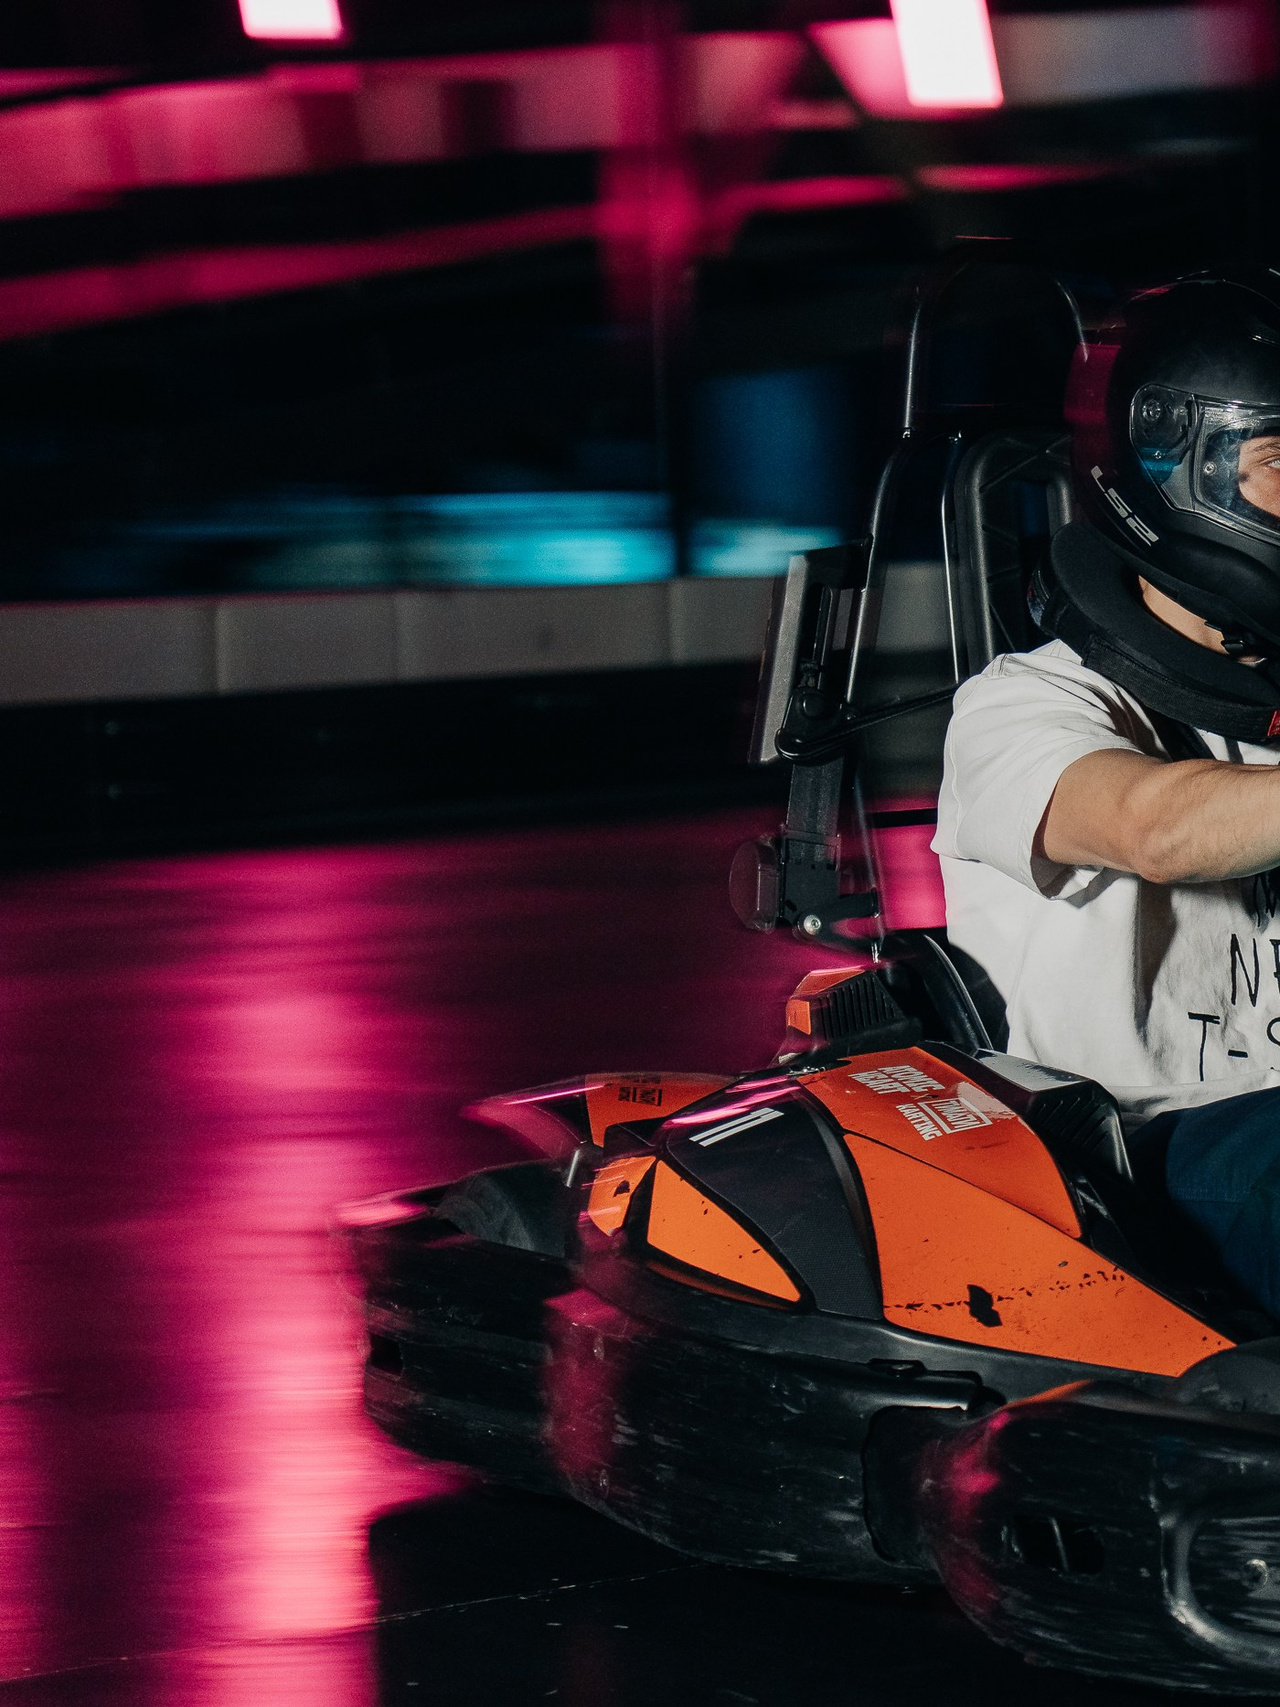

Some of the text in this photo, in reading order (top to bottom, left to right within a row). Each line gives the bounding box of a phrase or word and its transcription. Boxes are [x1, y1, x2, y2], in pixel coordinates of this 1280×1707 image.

[1091, 465, 1159, 546] LS2
[848, 1070, 911, 1094] HEART
[877, 1065, 946, 1092] ATOMIC
[689, 1107, 785, 1148] 11
[895, 1103, 943, 1141] KARTING
